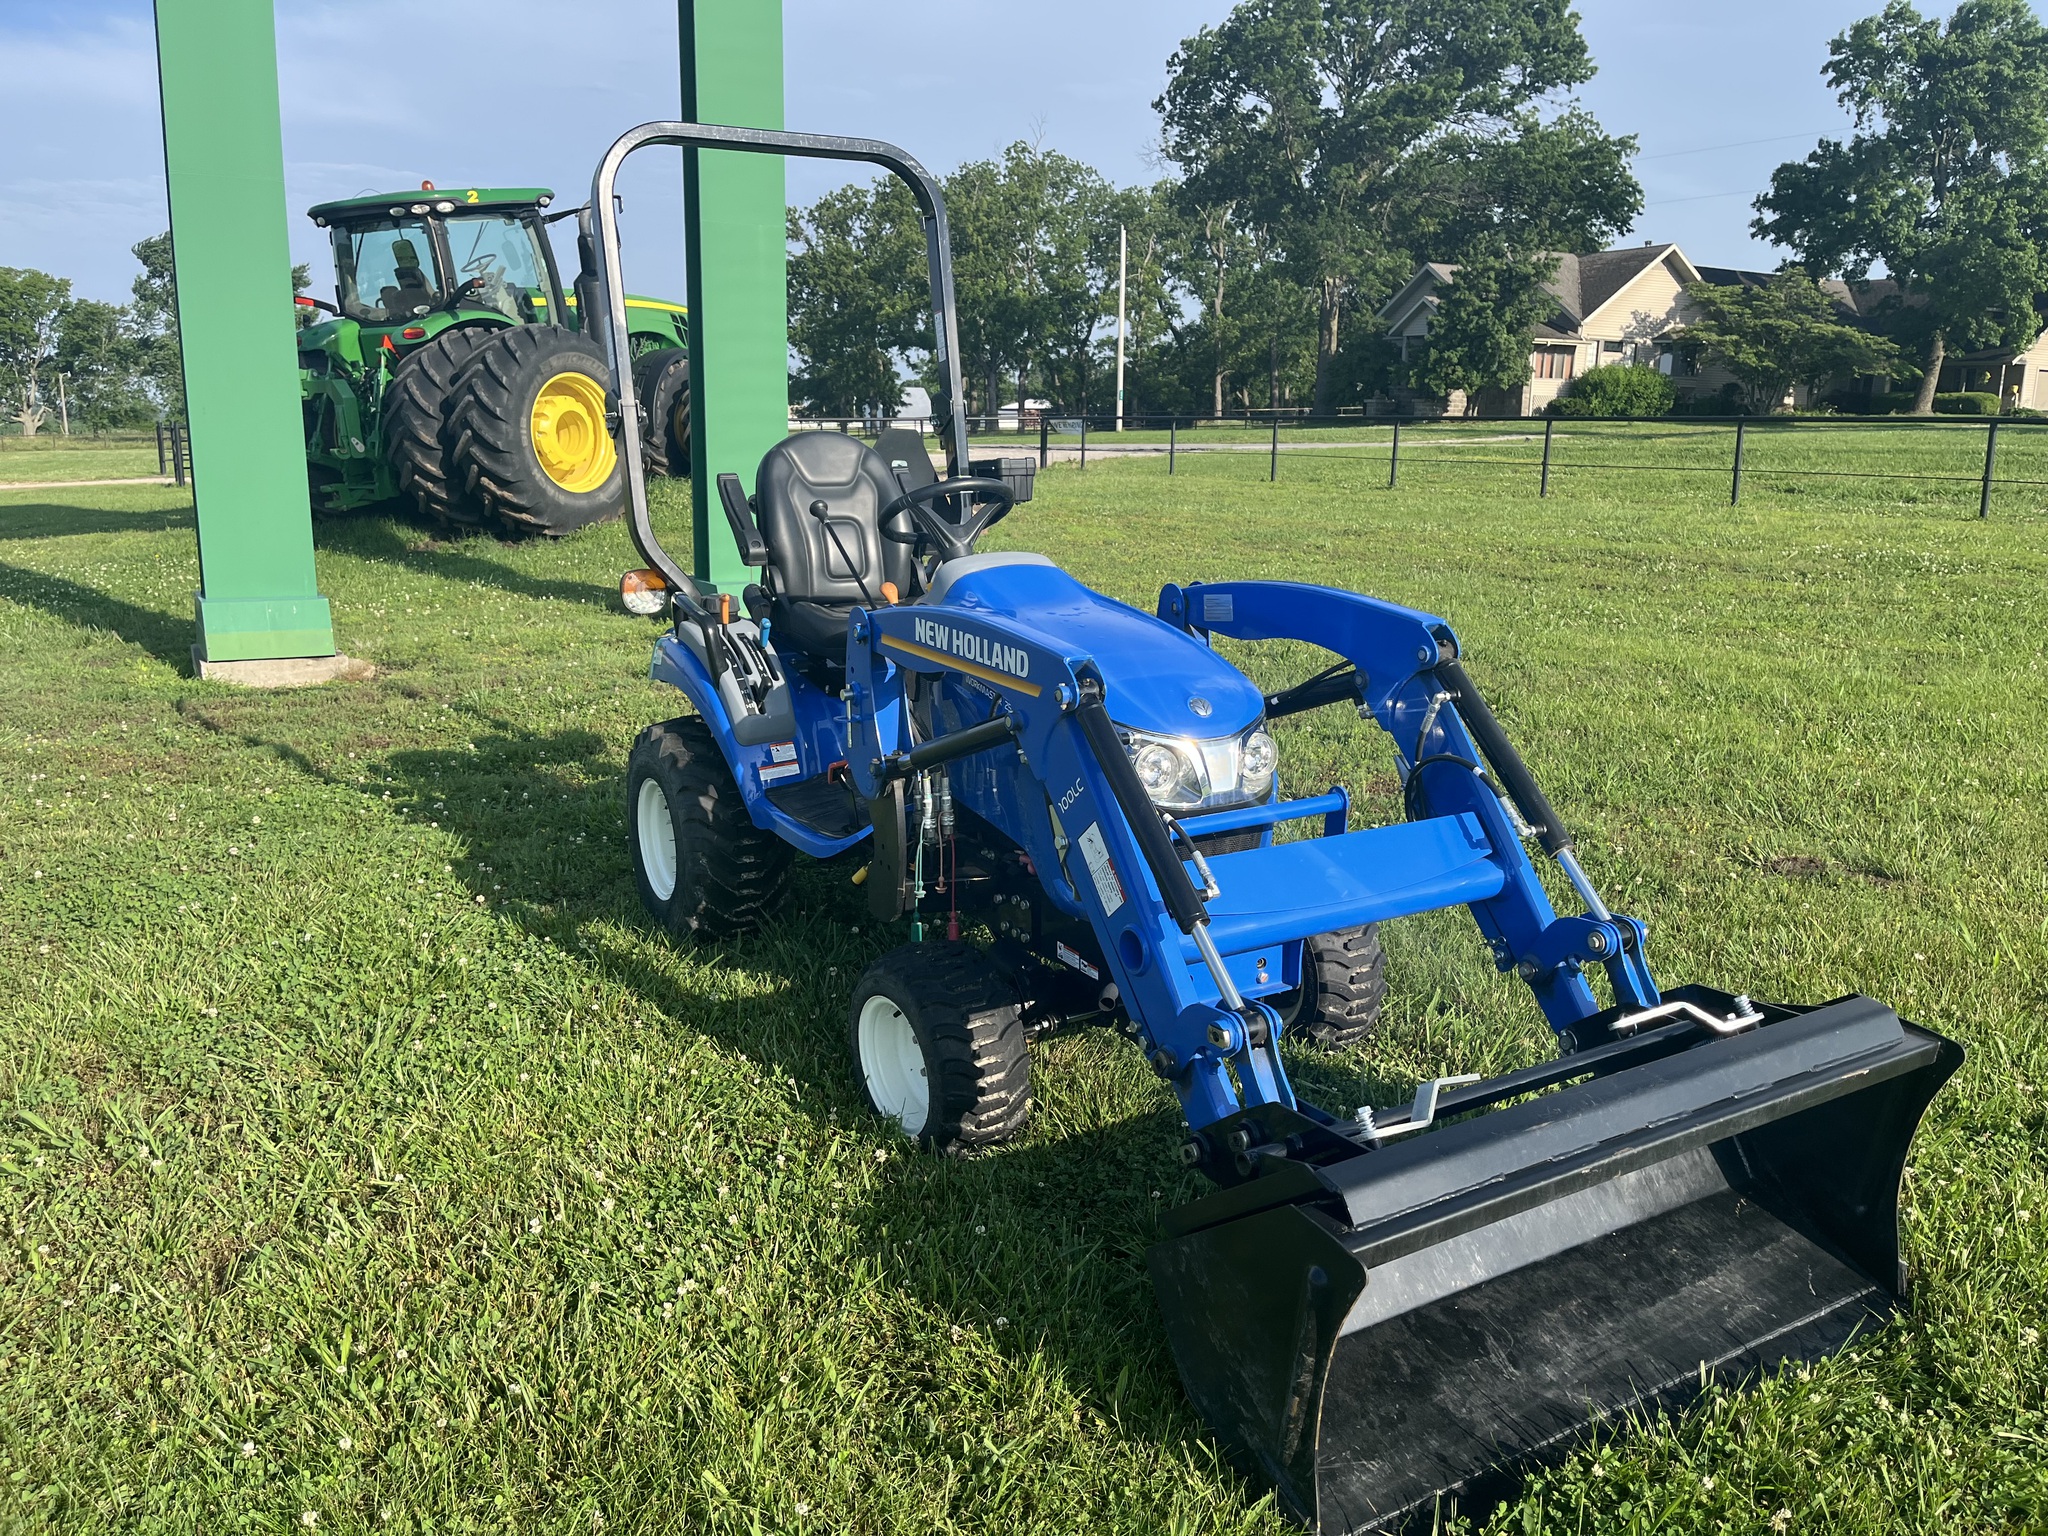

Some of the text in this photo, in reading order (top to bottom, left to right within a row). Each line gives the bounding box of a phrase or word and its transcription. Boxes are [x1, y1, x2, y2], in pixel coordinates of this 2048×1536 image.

[467, 190, 479, 203] 2
[915, 616, 1029, 678] NEW HOLLAND
[1058, 778, 1084, 813] 100LC
